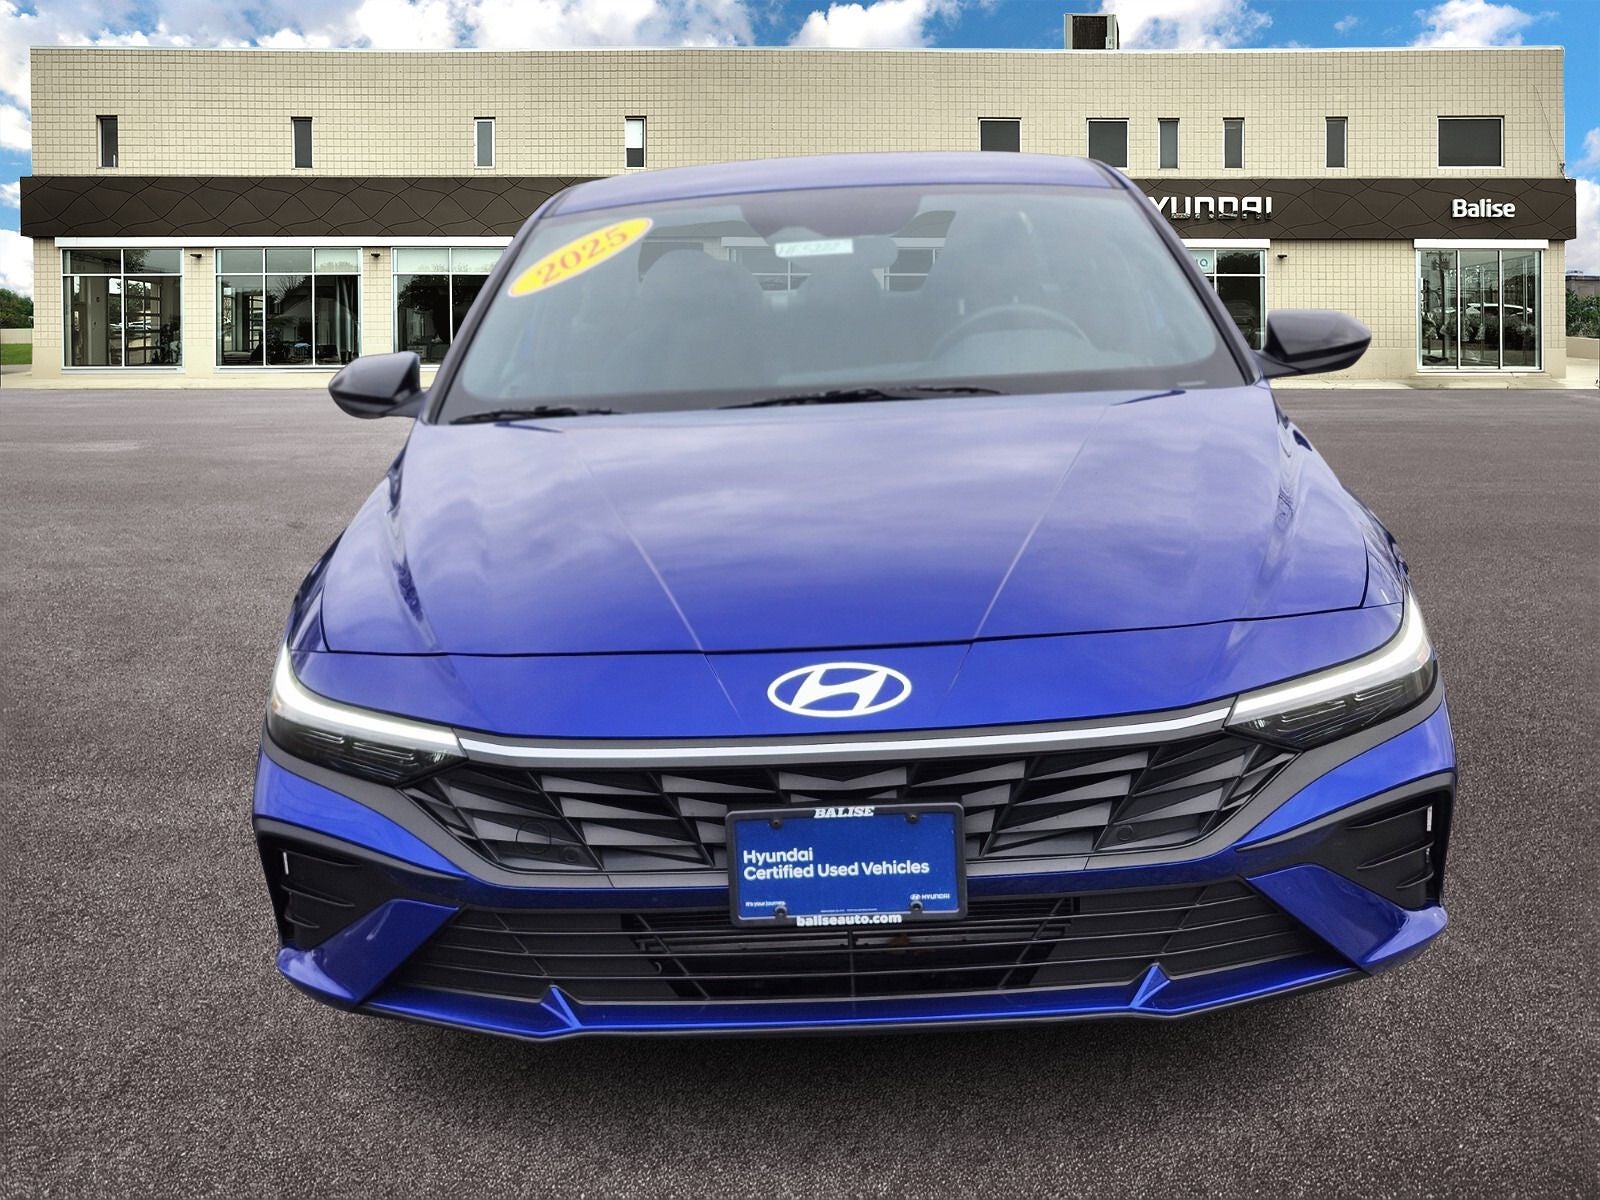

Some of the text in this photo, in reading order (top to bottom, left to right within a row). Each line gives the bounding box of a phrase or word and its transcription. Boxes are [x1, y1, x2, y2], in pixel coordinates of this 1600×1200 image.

[1147, 196, 1273, 220] YUNDAI
[1452, 198, 1516, 218] Balise
[537, 227, 628, 284] 2025
[813, 806, 876, 819] BALISE
[743, 847, 813, 866] Hyundai
[743, 859, 930, 880] Certified Used Vehicles
[796, 914, 902, 927] baliseauto.com
